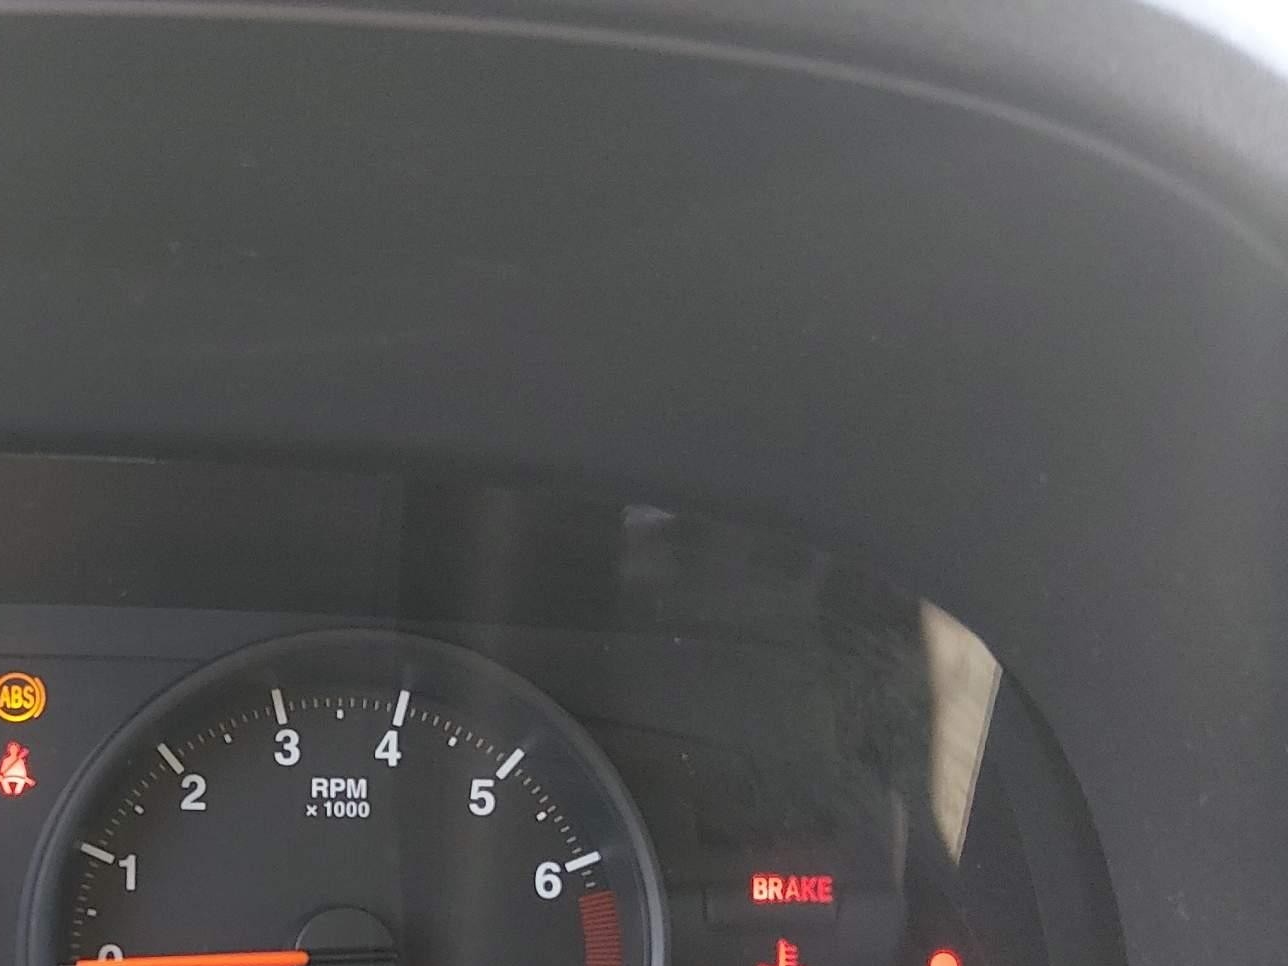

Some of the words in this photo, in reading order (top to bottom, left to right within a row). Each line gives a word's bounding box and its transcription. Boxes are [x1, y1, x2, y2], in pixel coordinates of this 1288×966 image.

[0, 685, 35, 709] ABS
[274, 729, 300, 766] 3
[375, 731, 401, 767] 4
[181, 775, 206, 811] 2
[312, 779, 367, 799] RPM
[469, 779, 495, 816] 5
[322, 801, 369, 819] 1000
[118, 855, 136, 890] 1
[535, 862, 562, 899] 6
[753, 874, 832, 902] BRAKE
